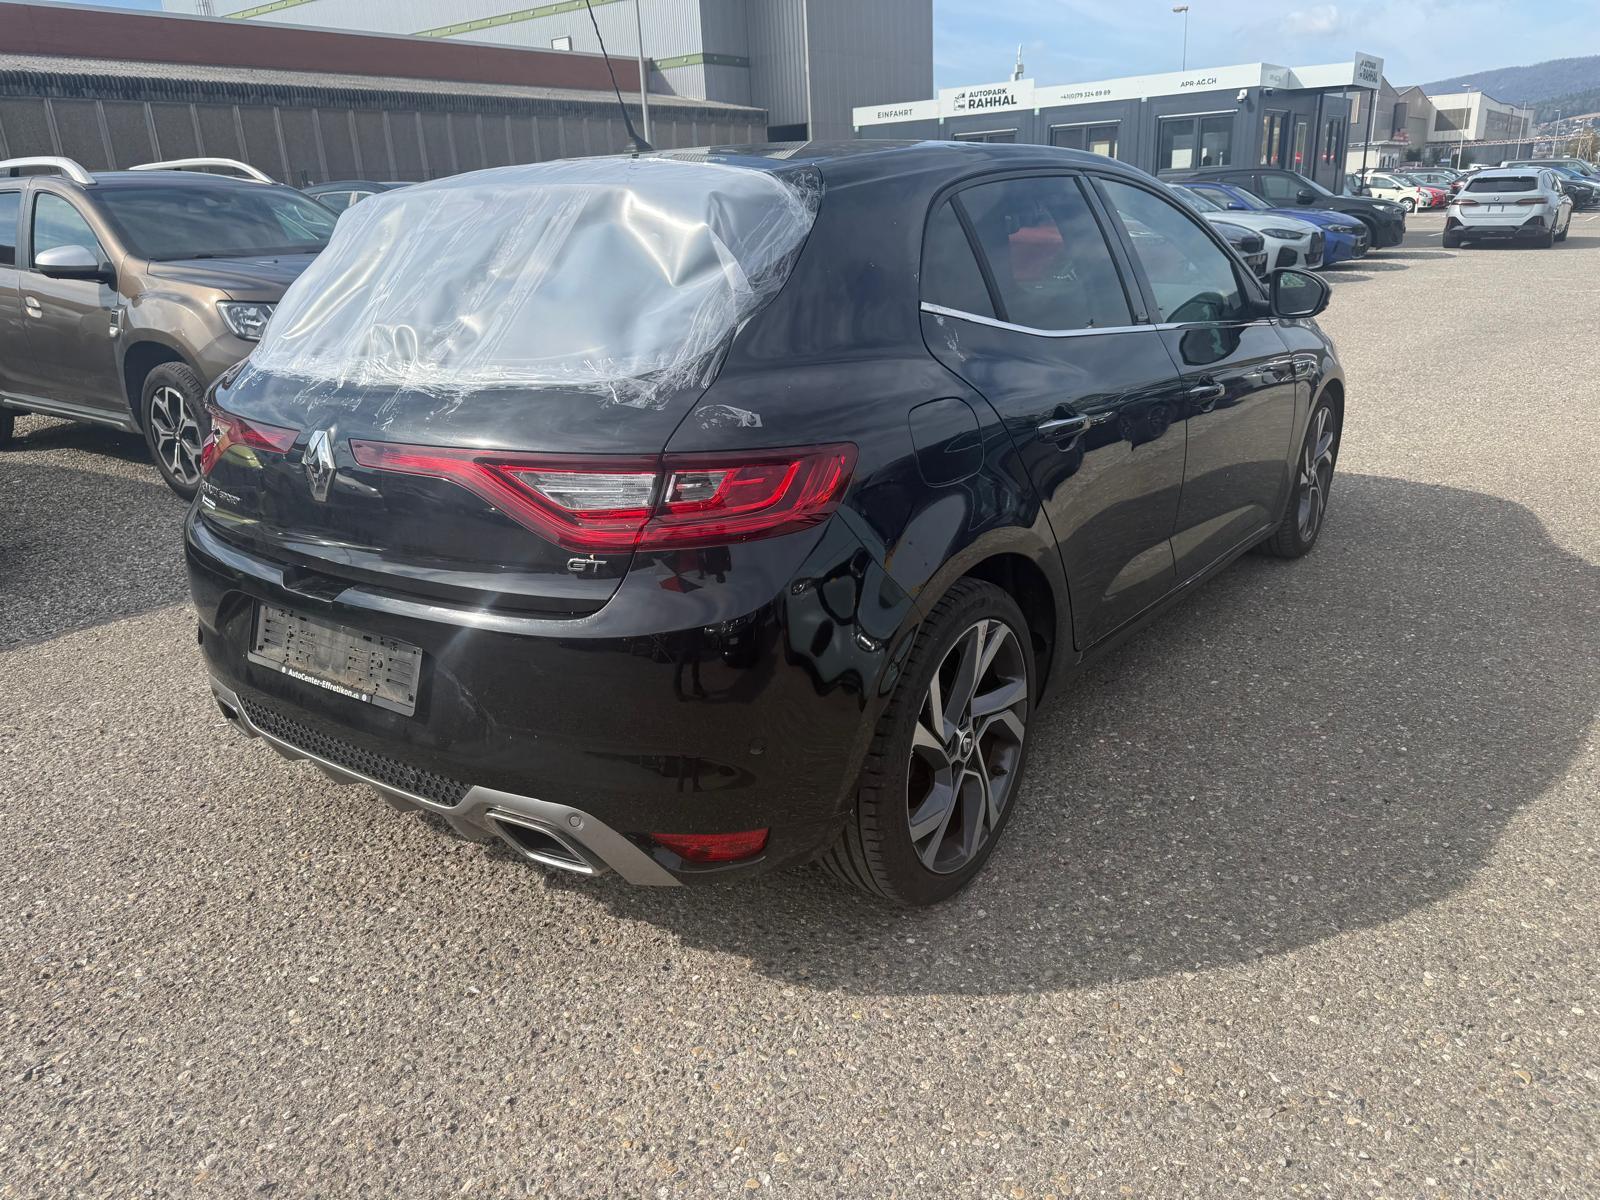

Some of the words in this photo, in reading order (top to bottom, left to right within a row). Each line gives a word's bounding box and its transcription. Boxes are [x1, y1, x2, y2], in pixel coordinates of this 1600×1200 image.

[968, 88, 1007, 98] AUTOPARK
[968, 94, 1018, 109] RAHHAL
[877, 108, 913, 119] EINFAHRT
[567, 557, 608, 573] GT
[287, 668, 360, 700] AutoCenter-Effretikon.ch
